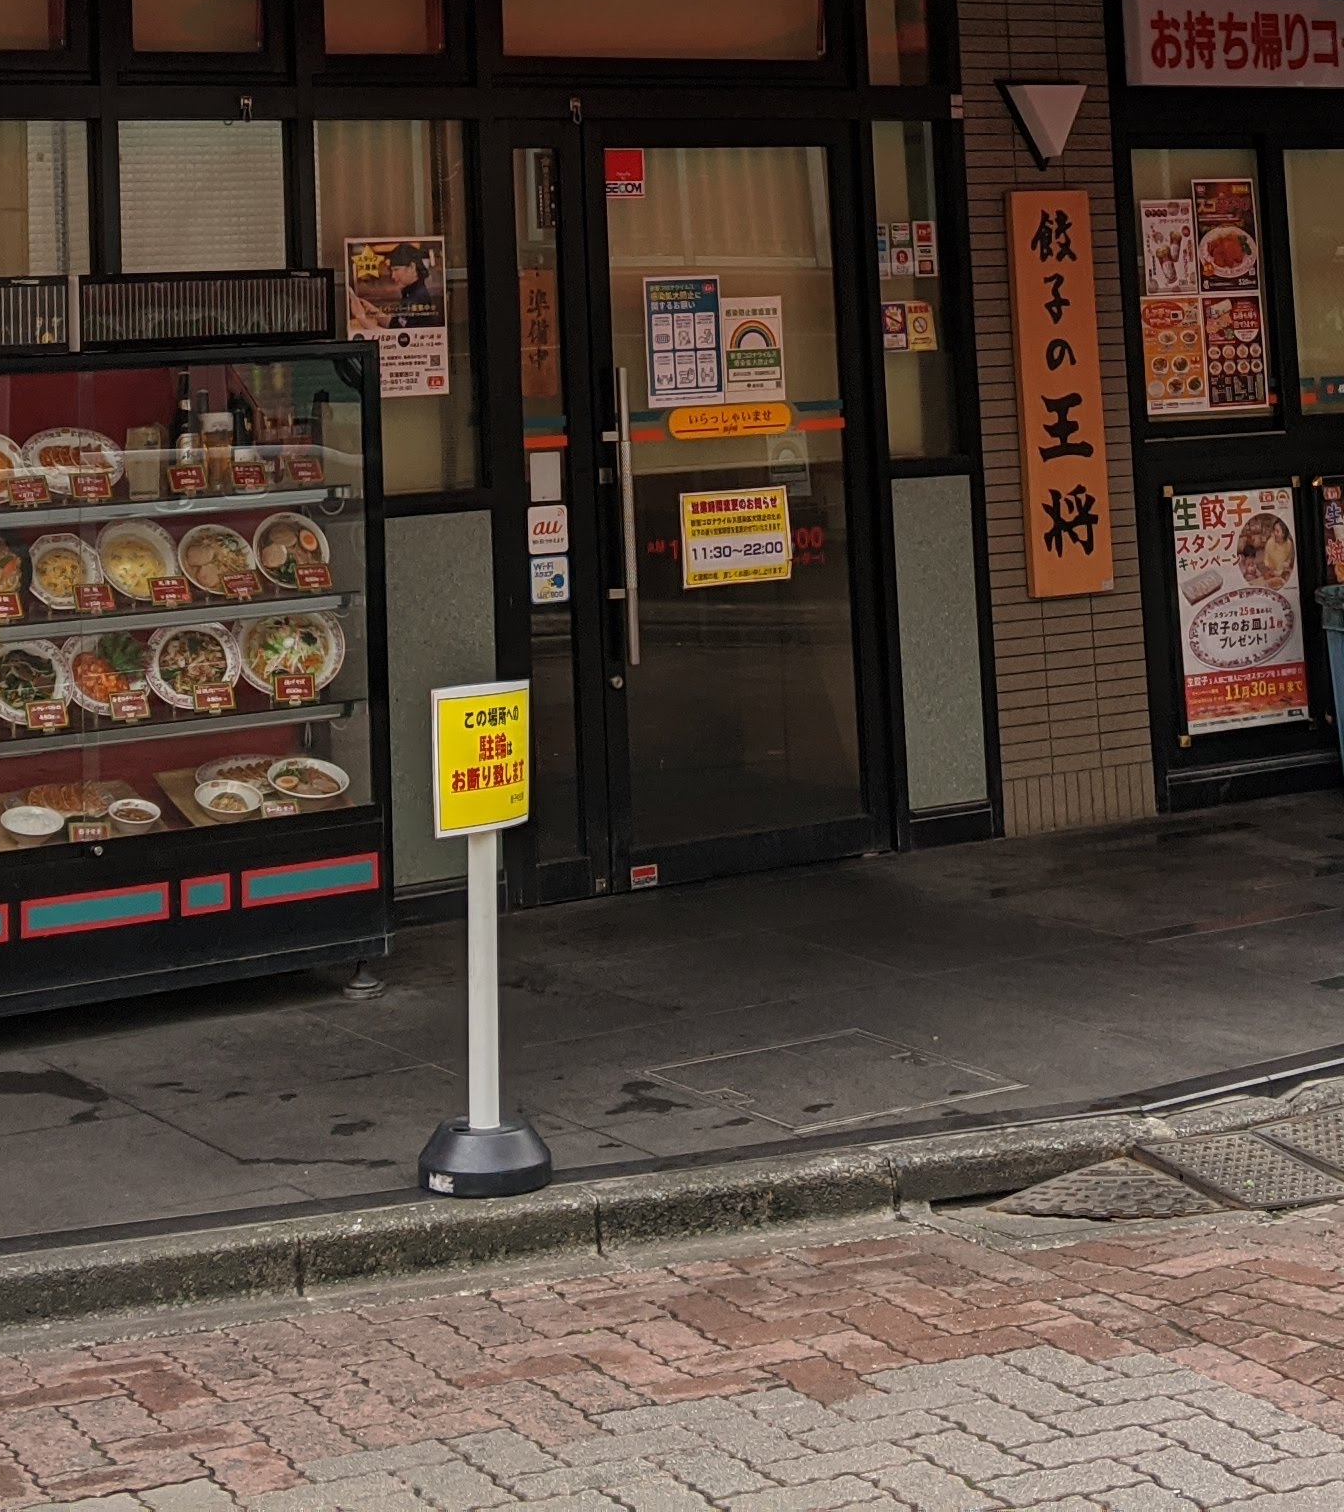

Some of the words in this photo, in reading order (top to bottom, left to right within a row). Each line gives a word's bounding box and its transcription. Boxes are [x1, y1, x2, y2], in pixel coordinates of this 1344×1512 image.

[605, 182, 642, 195] SECOM
[526, 289, 551, 371] 準備中
[1030, 209, 1099, 557] 餃子の王将
[689, 410, 772, 425] いらっしゃいませ
[1173, 494, 1252, 532] 生餃子
[532, 521, 563, 536] au
[1176, 530, 1235, 555] スタンプ
[1178, 554, 1242, 571] キャンペーン
[464, 705, 519, 728] この場所への
[478, 732, 513, 762] 駐輪は
[451, 759, 525, 792] お断り致します
